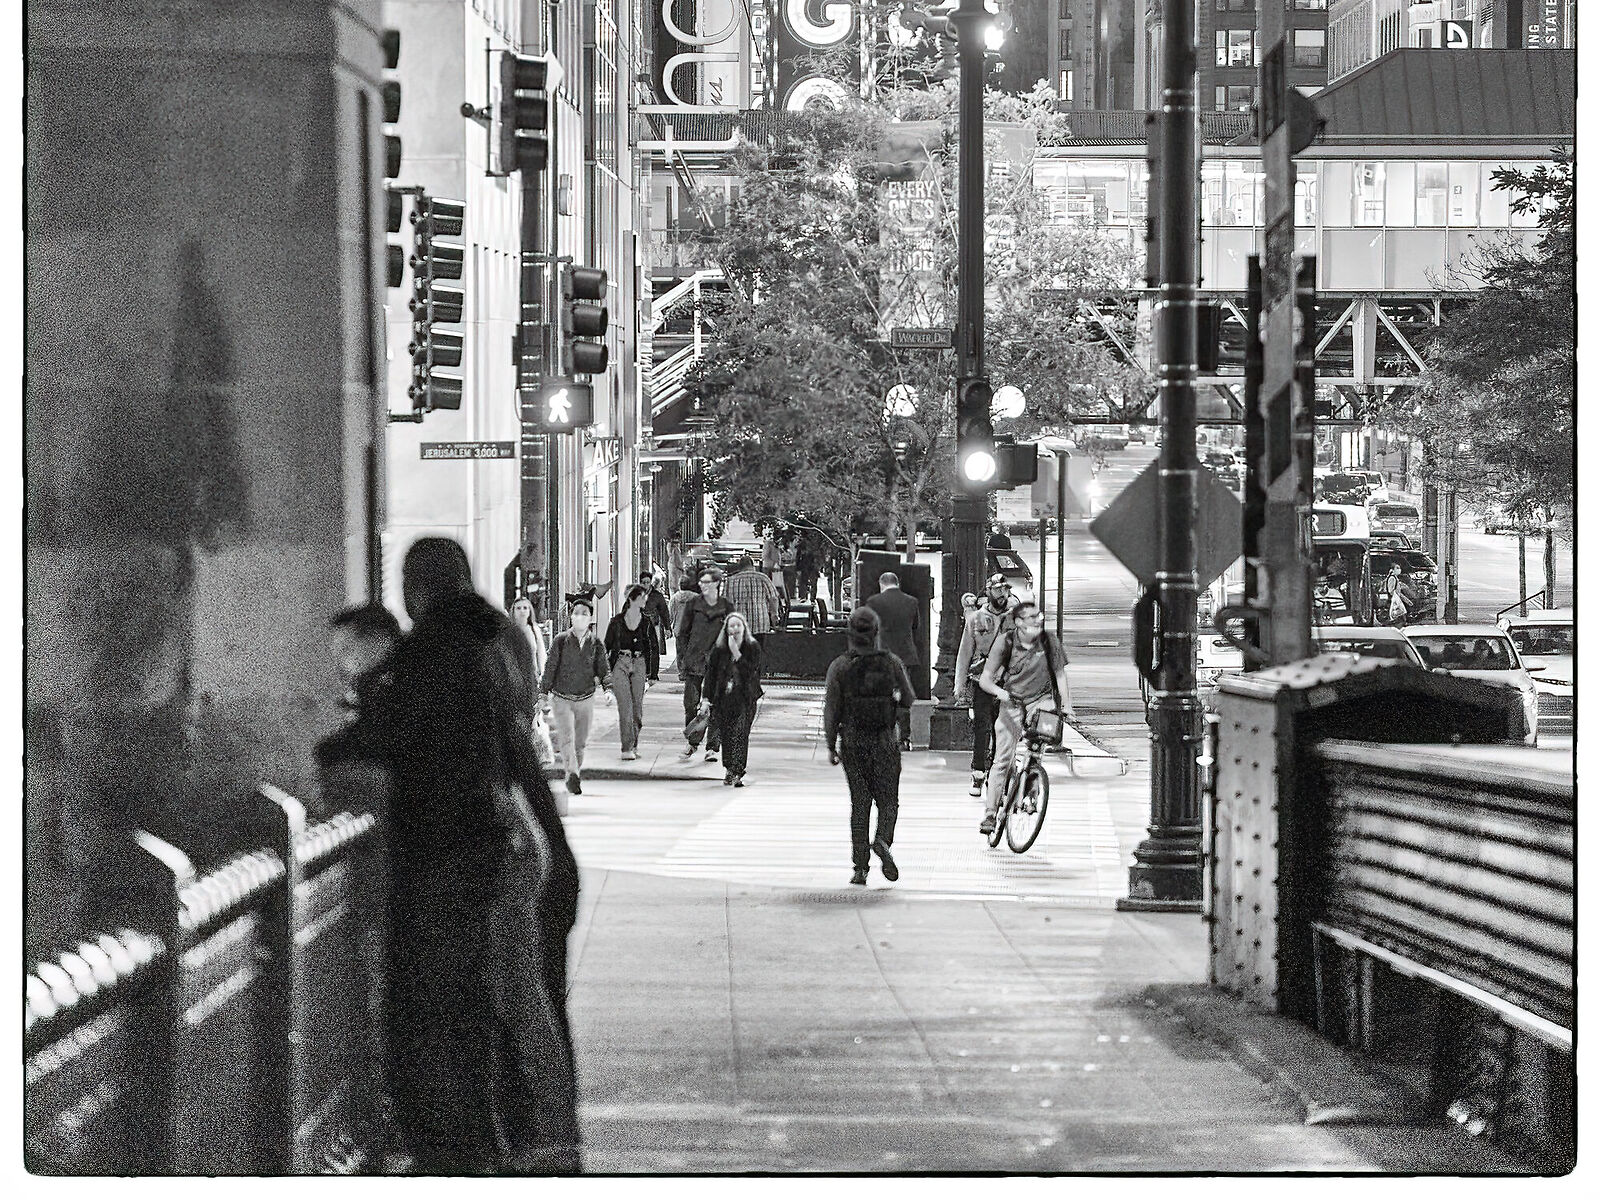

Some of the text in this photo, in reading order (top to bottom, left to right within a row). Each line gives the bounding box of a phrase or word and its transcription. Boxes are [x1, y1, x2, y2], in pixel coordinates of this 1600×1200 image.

[888, 180, 935, 198] EVERY
[888, 199, 935, 220] ONS
[423, 448, 471, 458] JERUSALEM
[474, 448, 498, 458] 3,000
